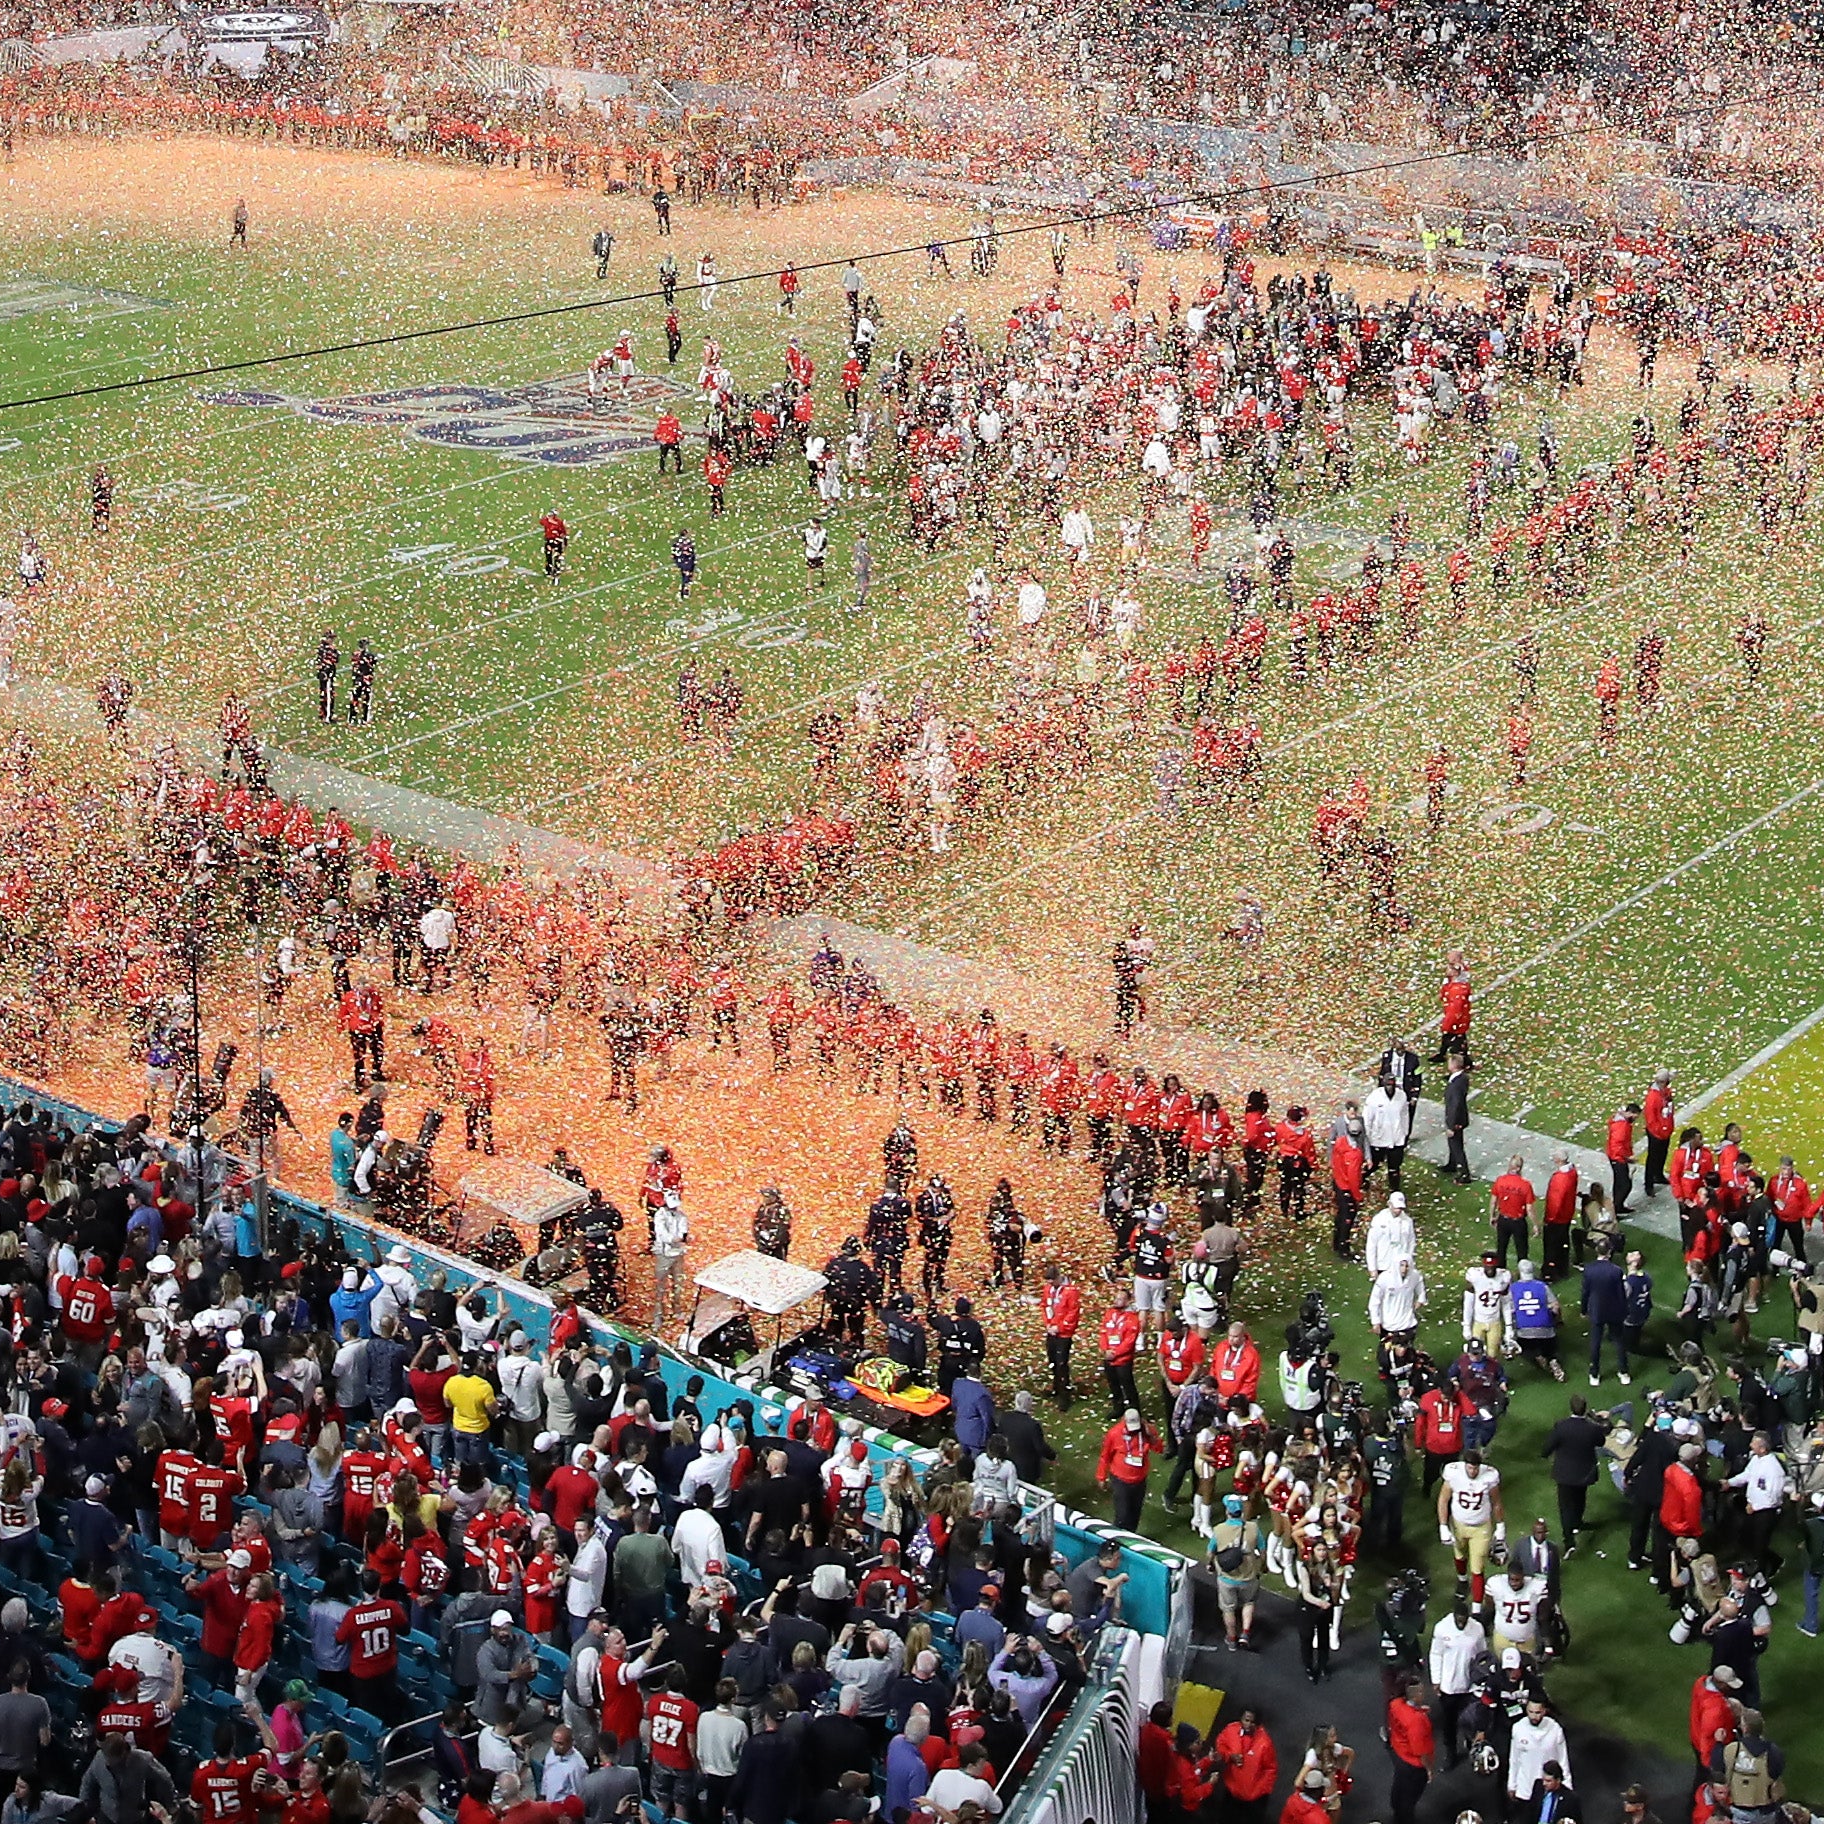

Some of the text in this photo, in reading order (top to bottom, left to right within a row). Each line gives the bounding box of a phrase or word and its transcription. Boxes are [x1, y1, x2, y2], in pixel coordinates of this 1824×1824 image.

[68, 1299, 95, 1325] 60
[1479, 1290, 1501, 1308] 47
[164, 1474, 186, 1501] 15
[349, 1475, 374, 1496] 15
[200, 1493, 217, 1522] 2
[1458, 1491, 1483, 1511] 67
[1502, 1601, 1531, 1624] 75
[360, 1627, 391, 1659] 10
[101, 1713, 142, 1728] SANDERS
[652, 1715, 684, 1748] 87
[210, 1790, 242, 1819] 15
